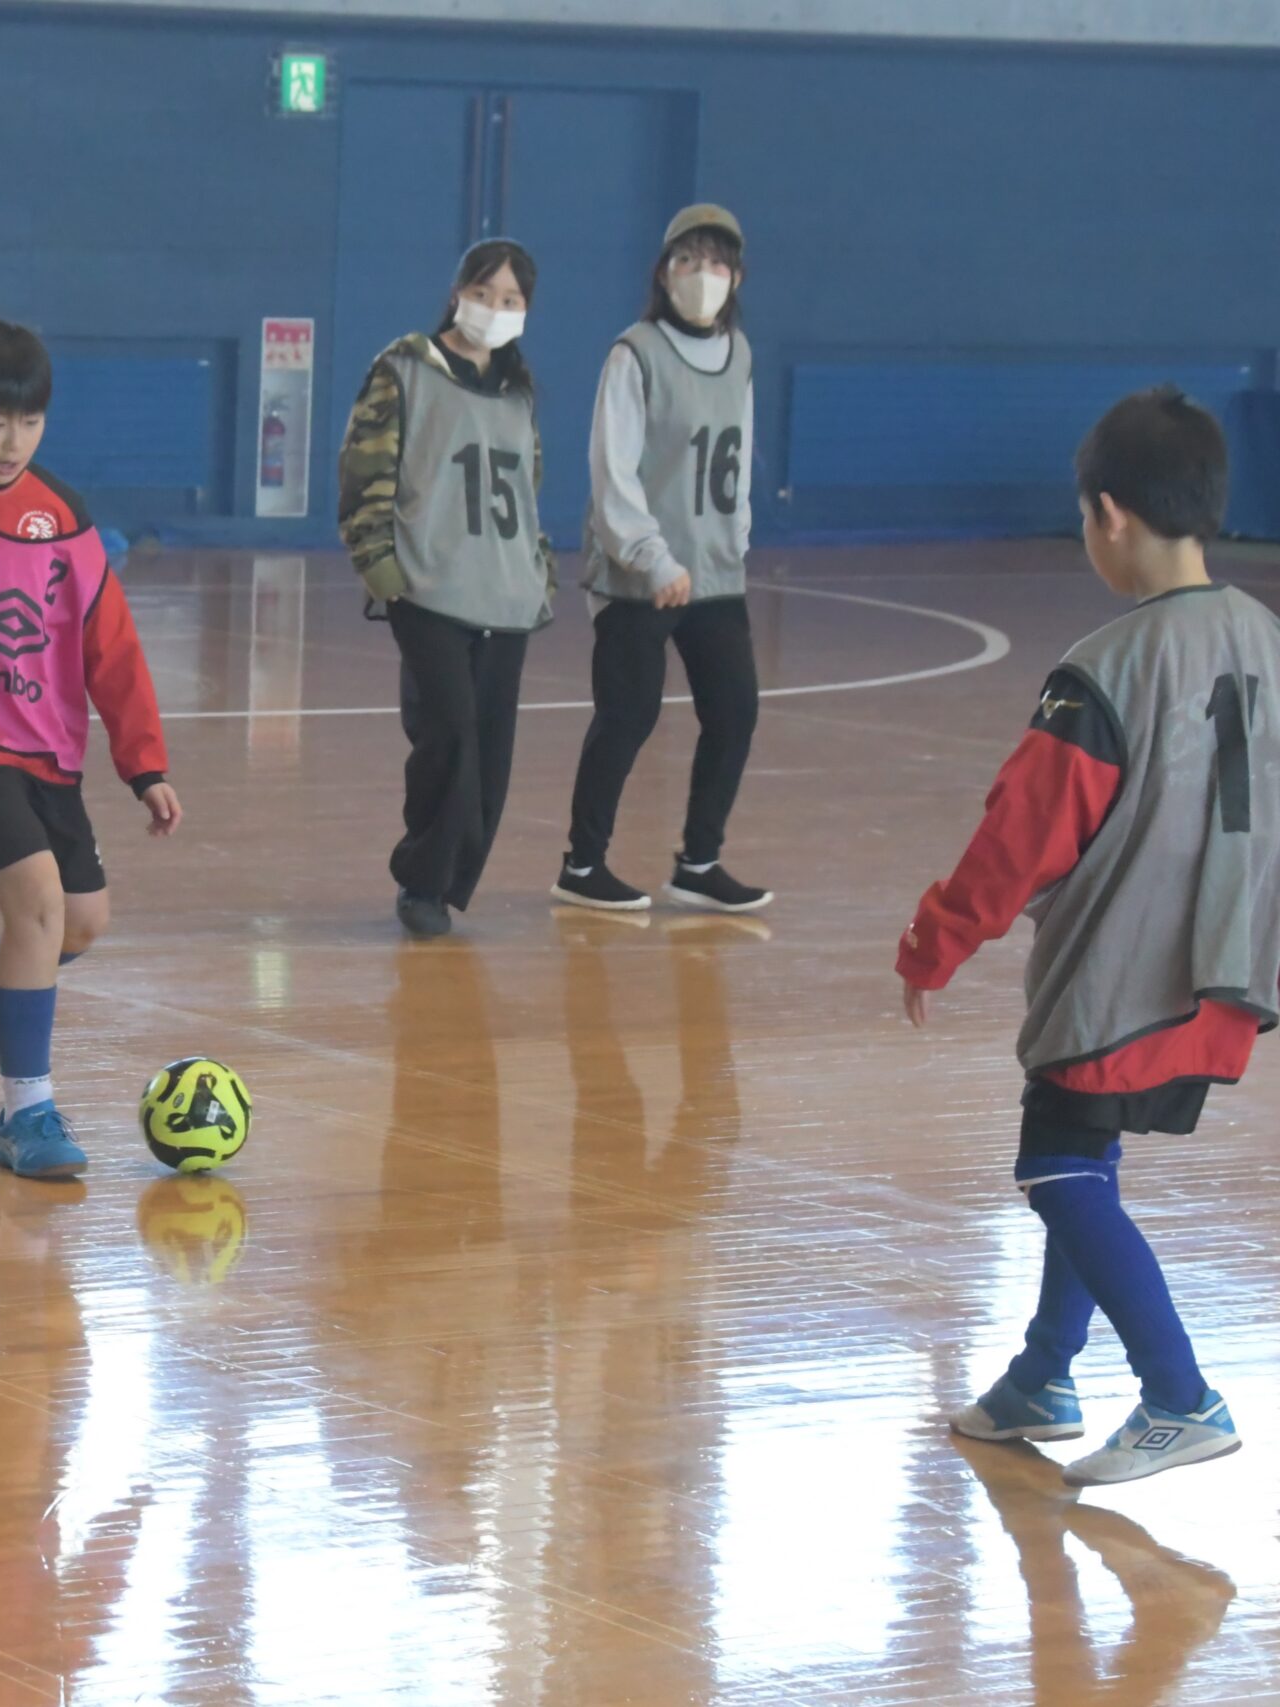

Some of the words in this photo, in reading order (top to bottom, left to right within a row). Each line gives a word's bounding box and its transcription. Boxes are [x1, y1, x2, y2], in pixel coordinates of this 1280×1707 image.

[451, 443, 520, 540] 15
[689, 425, 742, 516] 16
[44, 558, 68, 606] 2
